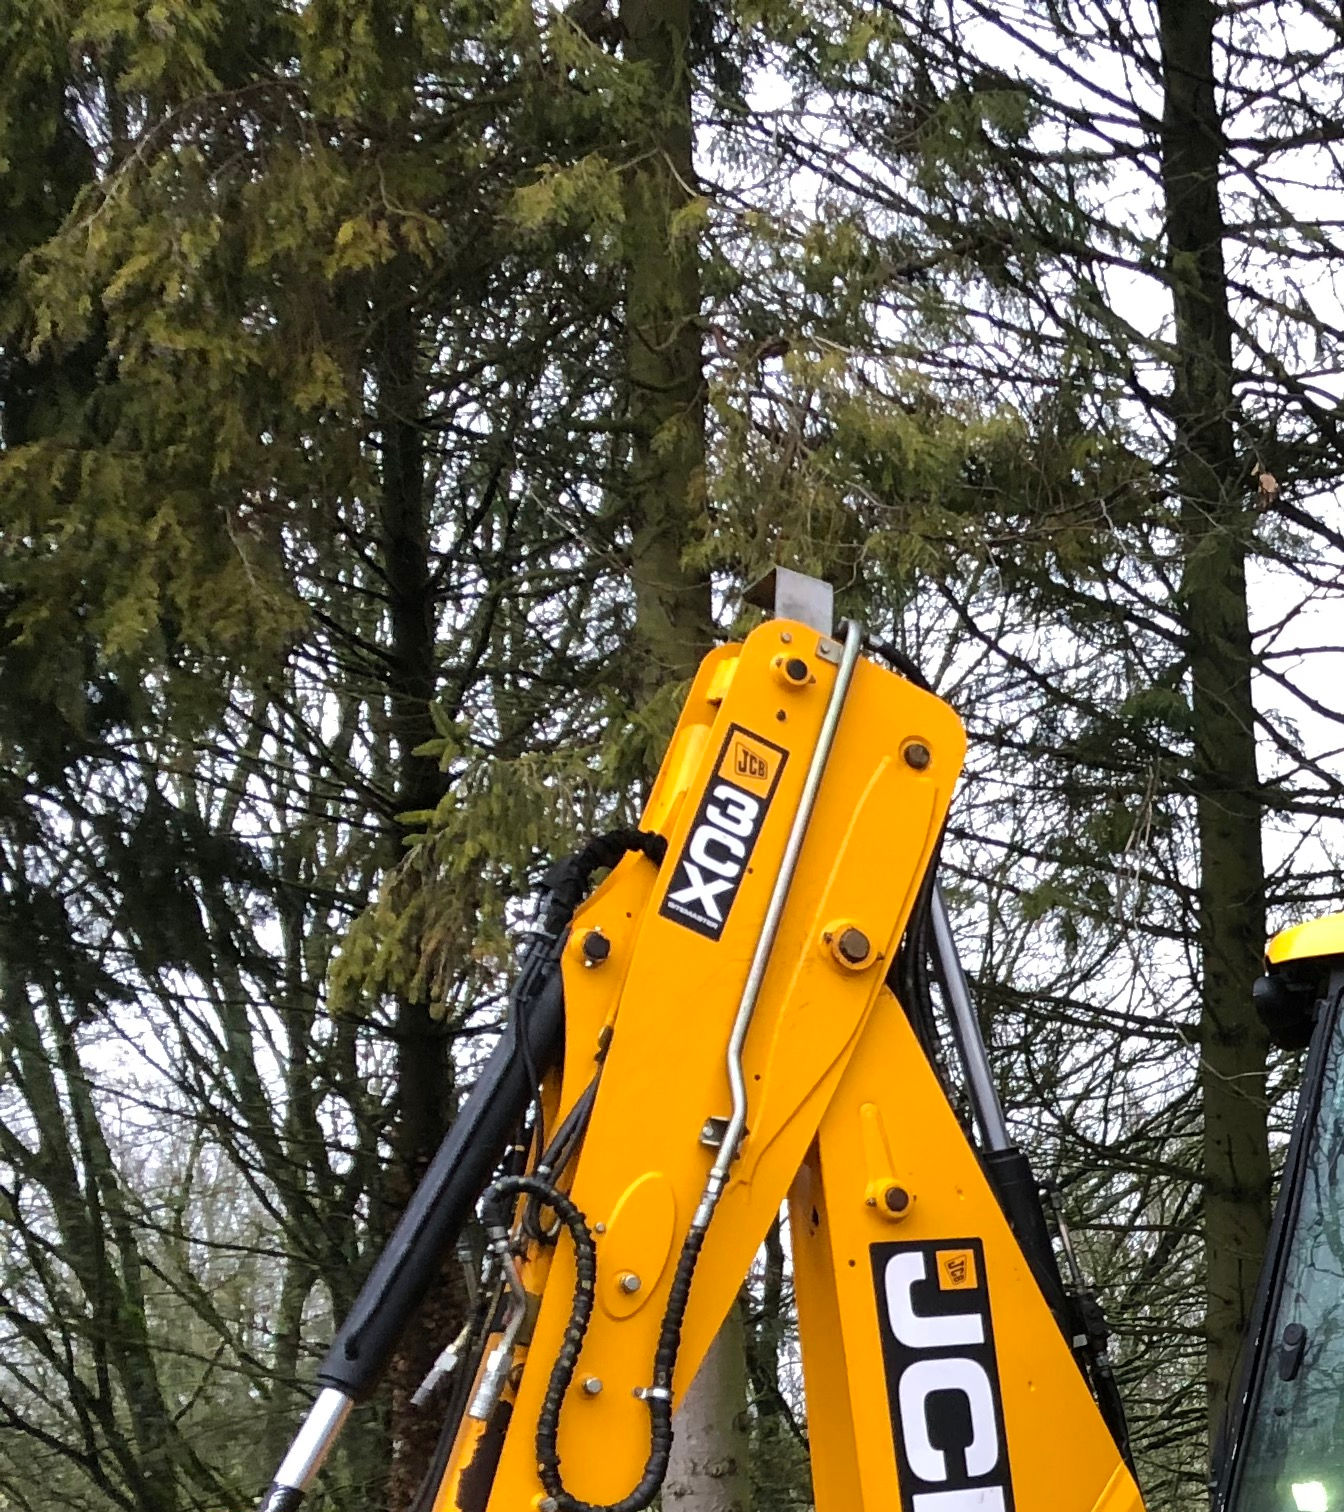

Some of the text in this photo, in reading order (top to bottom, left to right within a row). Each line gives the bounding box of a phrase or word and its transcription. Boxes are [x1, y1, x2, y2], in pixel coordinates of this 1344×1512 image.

[738, 749, 766, 777] JCB
[667, 784, 760, 923] 3CX
[667, 901, 719, 930] SITEMASTER
[947, 1259, 966, 1283] JCB
